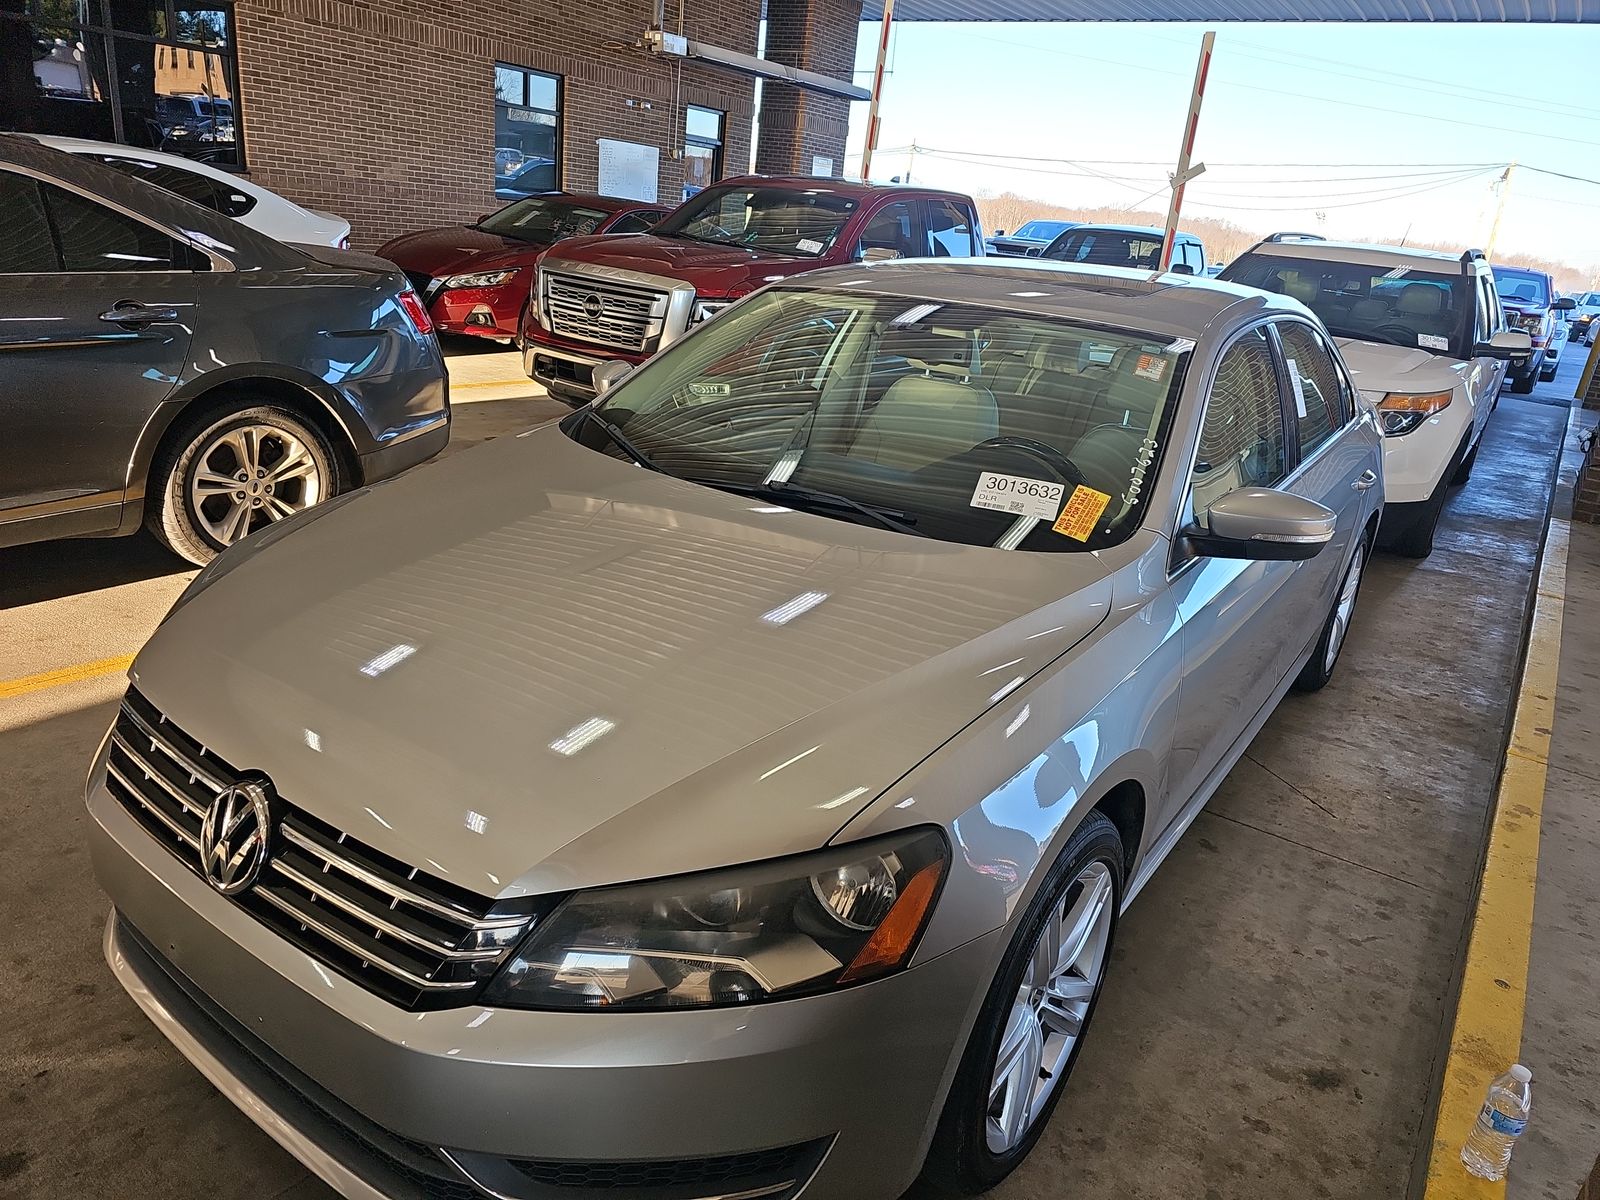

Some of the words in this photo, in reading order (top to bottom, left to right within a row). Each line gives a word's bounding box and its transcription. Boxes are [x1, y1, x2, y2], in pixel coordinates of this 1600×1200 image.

[978, 493, 998, 502] DLR
[986, 476, 1061, 501] 3013632
[1054, 517, 1066, 531] THIS
[1062, 493, 1080, 517] VEHICLE
[1062, 518, 1074, 531] NOT
[1070, 505, 1081, 518] FOR
[1076, 491, 1090, 506] SALE
